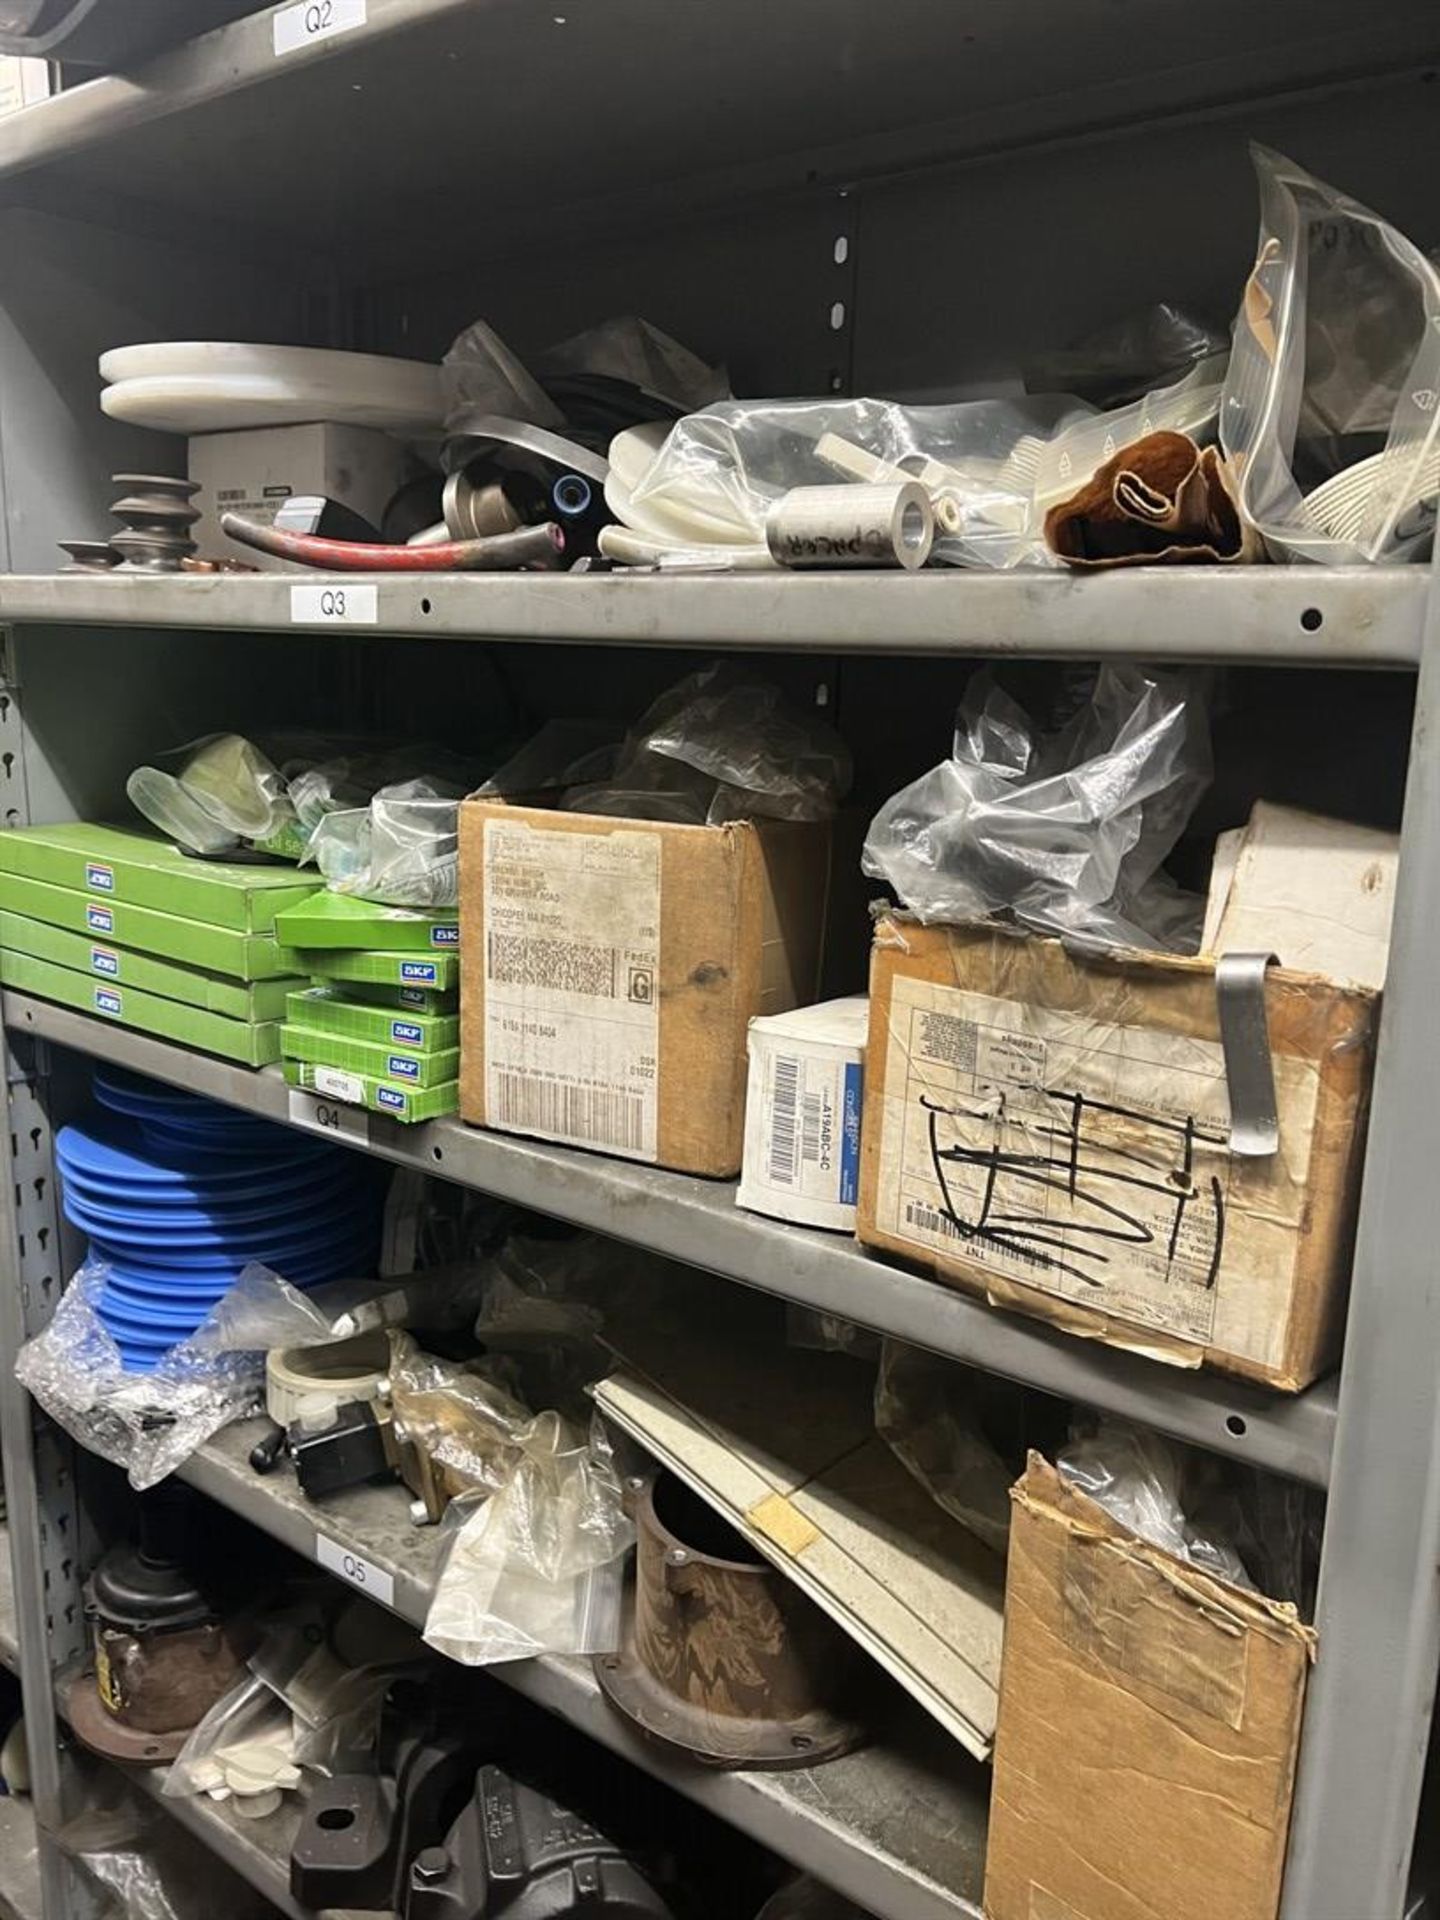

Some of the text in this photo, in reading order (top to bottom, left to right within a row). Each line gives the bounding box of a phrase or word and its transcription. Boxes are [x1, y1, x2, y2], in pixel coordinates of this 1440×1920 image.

[305, 0, 333, 33] Q2
[320, 591, 345, 615] Q3
[435, 928, 459, 941] SK
[624, 950, 656, 963] FedEx
[403, 964, 434, 978] SKF
[633, 972, 648, 1000] G
[394, 1025, 421, 1037] SKF
[390, 1058, 418, 1072] SKF
[379, 1091, 405, 1106] SKF
[316, 1104, 340, 1130] Q4
[965, 1244, 985, 1261] TNT
[343, 1555, 366, 1582] Q5
